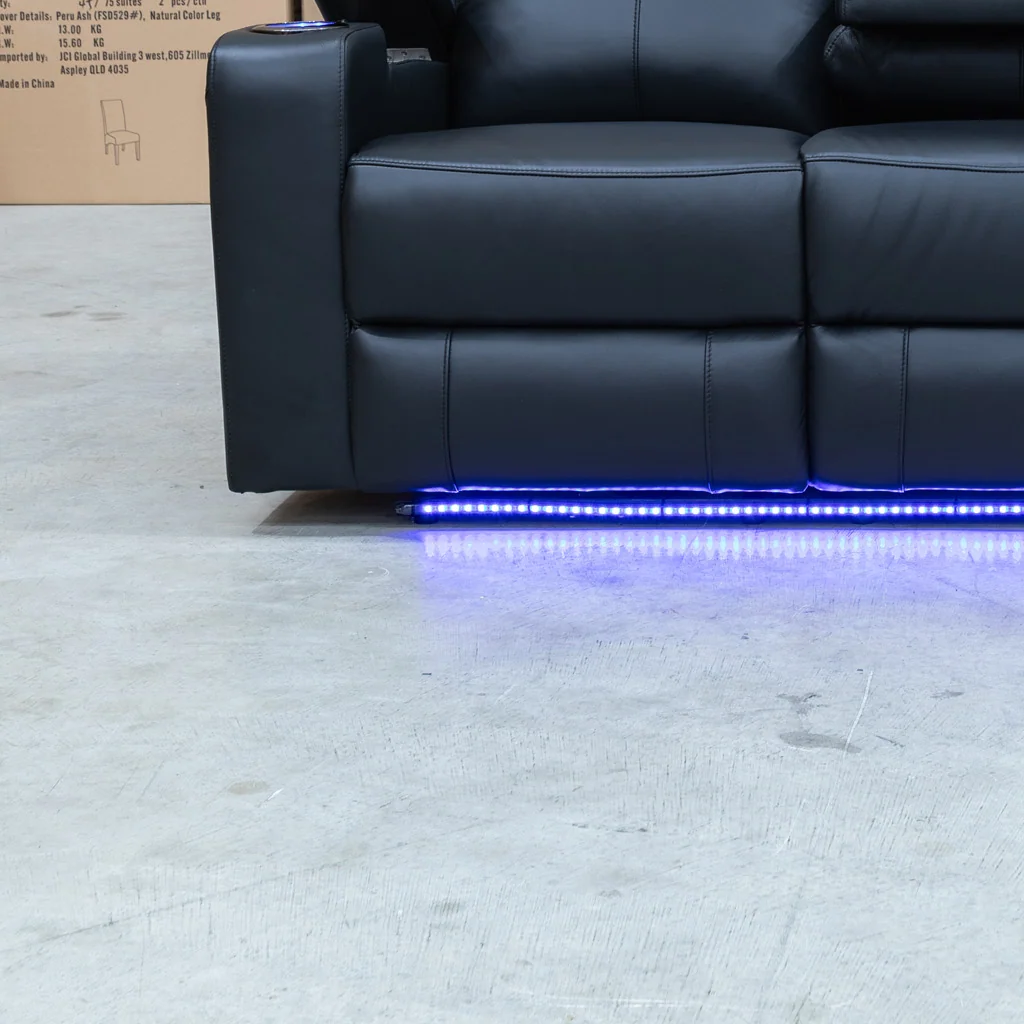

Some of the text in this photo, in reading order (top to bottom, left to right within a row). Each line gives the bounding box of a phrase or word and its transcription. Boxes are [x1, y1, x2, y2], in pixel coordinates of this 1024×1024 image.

[60, 64, 129, 76] Aspley QLD 4035
